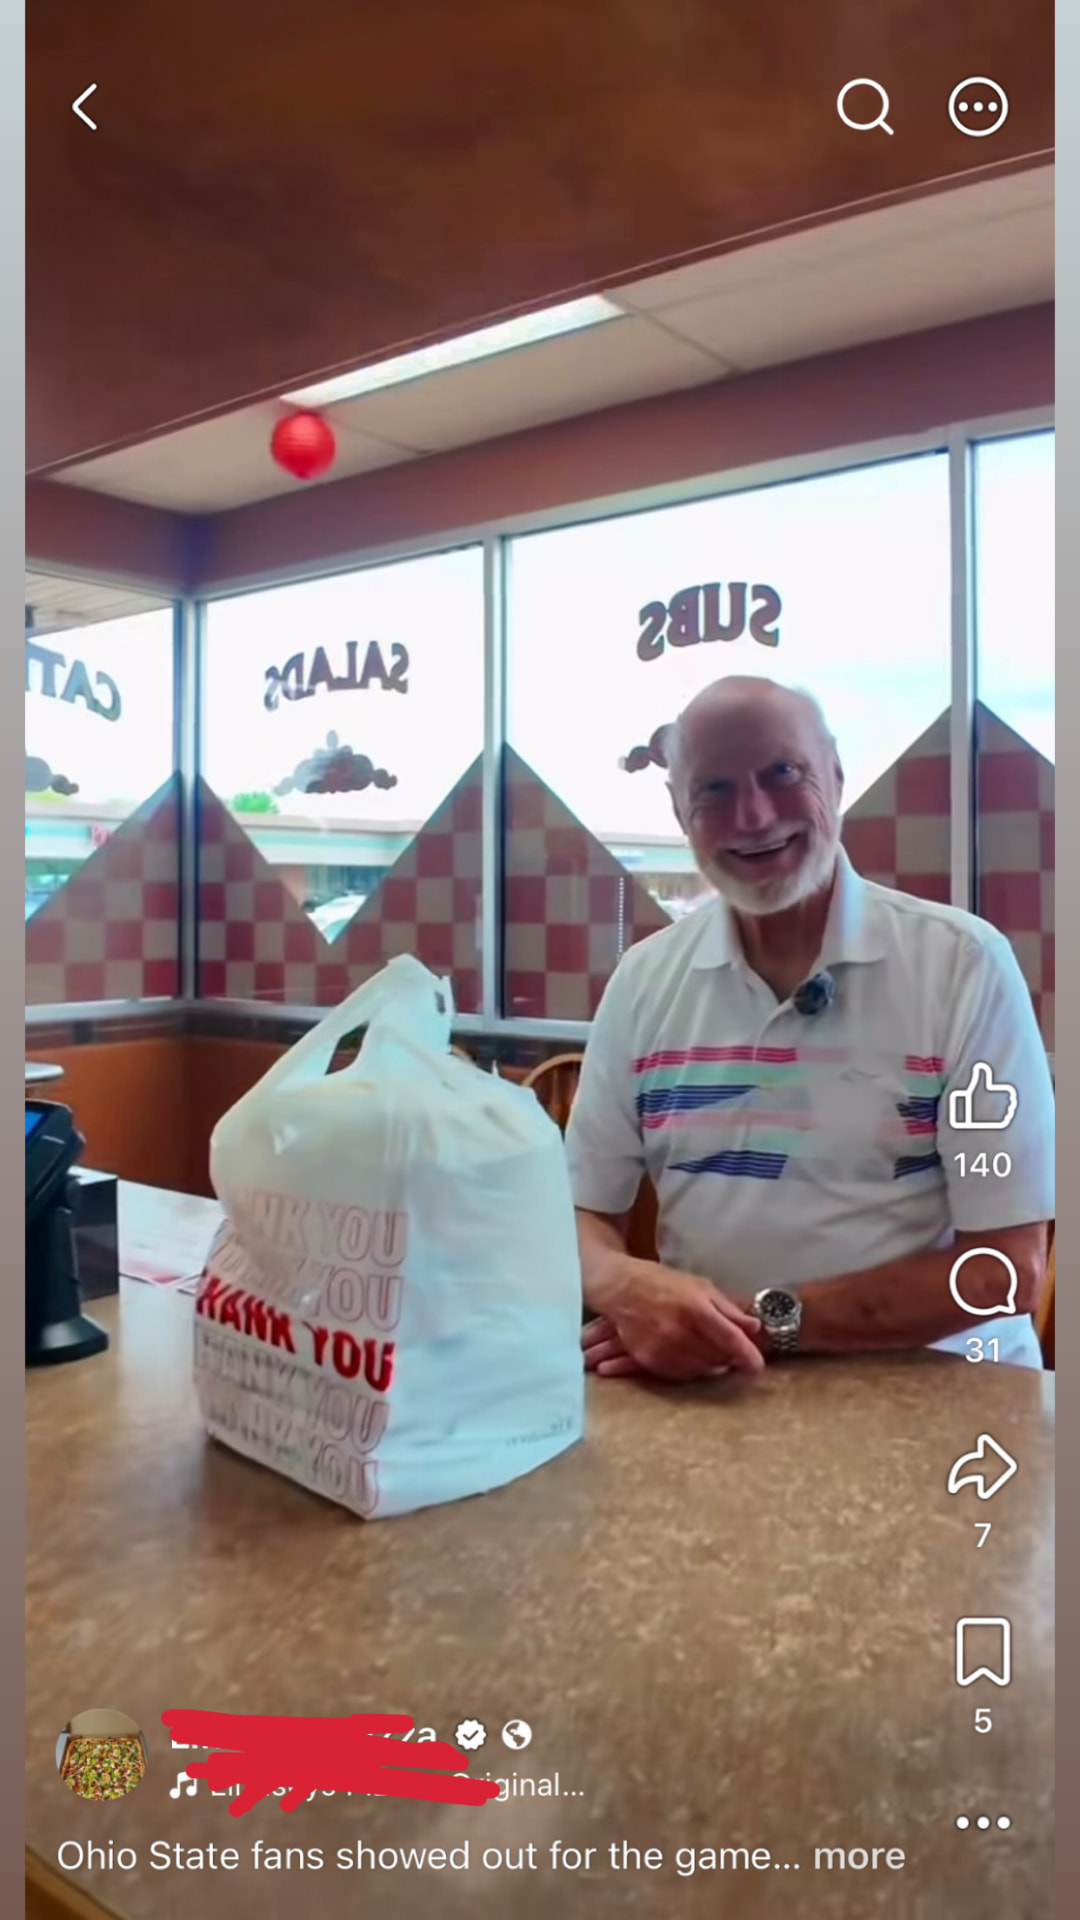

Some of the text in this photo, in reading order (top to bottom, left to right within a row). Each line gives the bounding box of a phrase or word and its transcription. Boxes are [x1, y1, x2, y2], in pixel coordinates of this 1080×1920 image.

[319, 1200, 409, 1268] YOU
[195, 1266, 297, 1355] HANK
[301, 1320, 395, 1392] YOU
